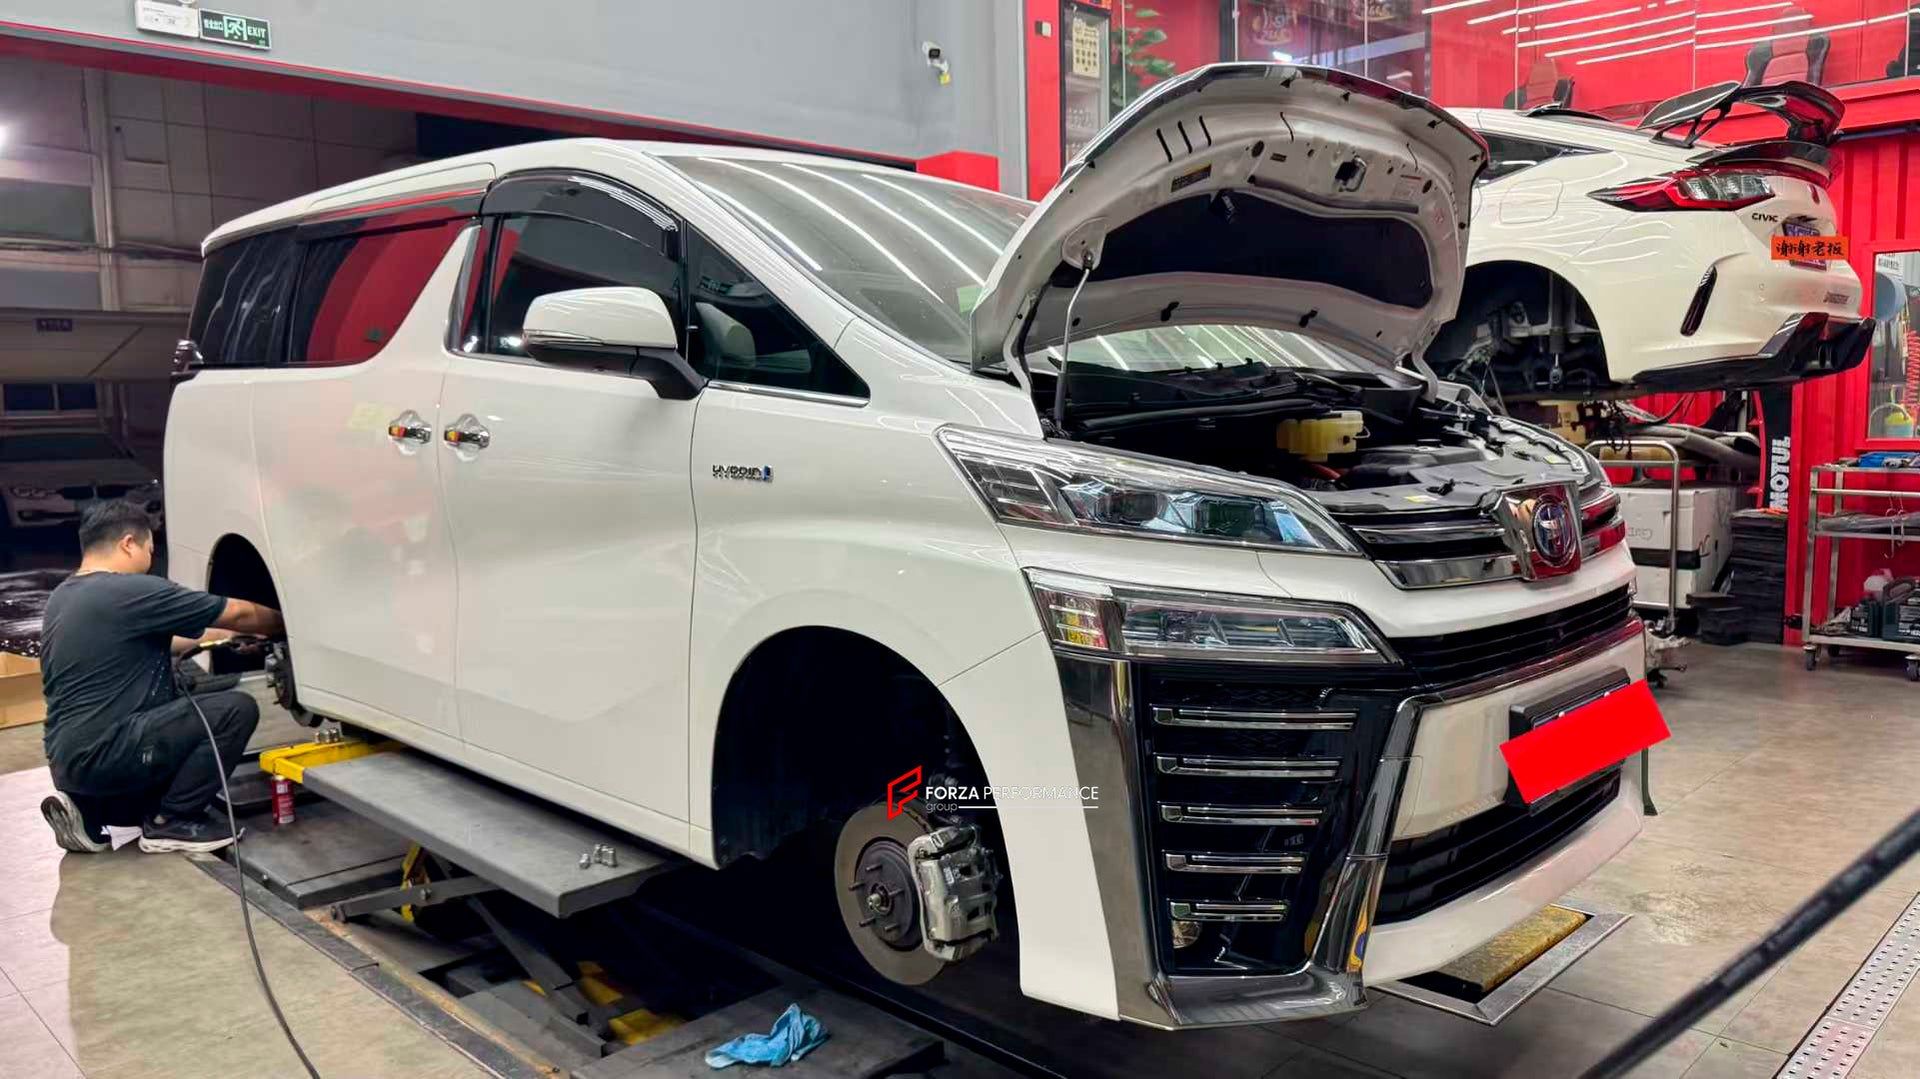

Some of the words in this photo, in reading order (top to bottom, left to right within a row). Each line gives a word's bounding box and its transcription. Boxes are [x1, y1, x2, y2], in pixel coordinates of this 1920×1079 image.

[247, 26, 267, 38] EXIT
[1751, 212, 1779, 222] CIVIC
[1769, 435, 1791, 512] MOTUL
